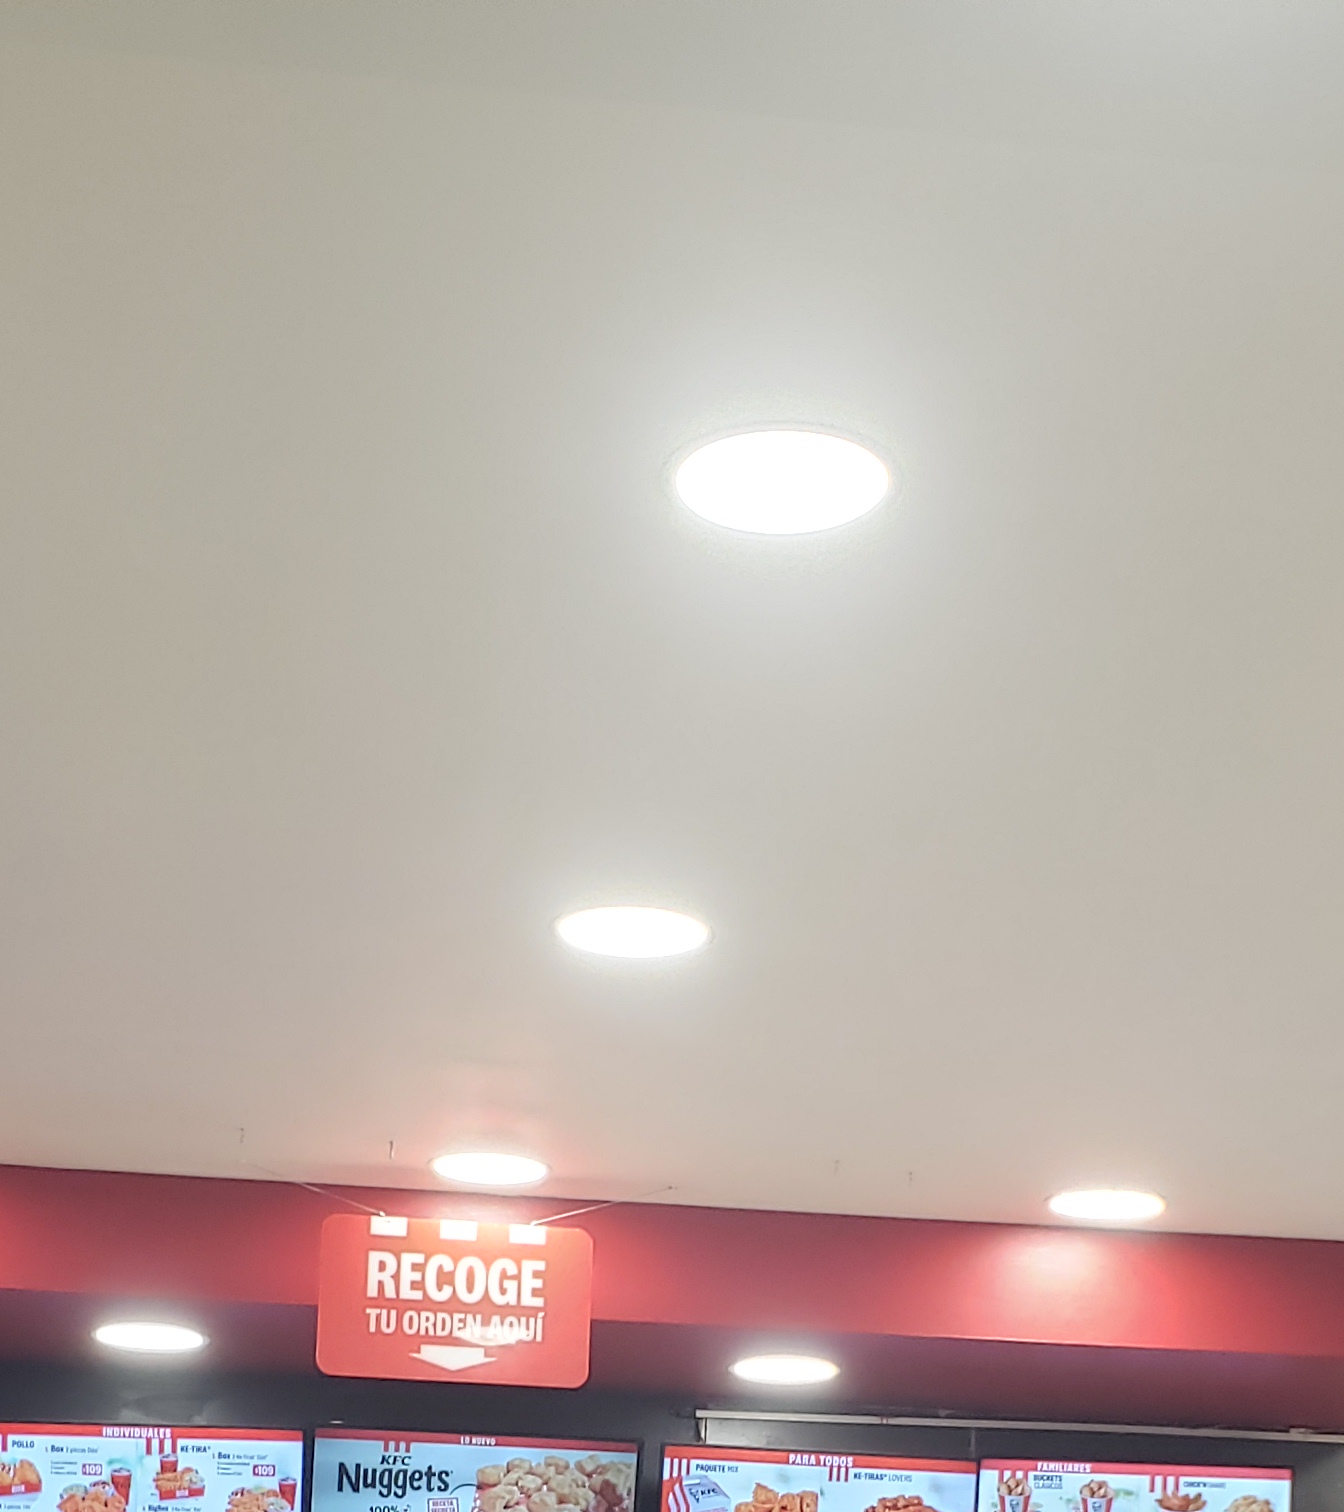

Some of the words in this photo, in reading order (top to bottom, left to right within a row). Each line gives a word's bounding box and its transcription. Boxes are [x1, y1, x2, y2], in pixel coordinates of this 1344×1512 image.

[366, 1250, 546, 1308] RECOGE
[366, 1308, 398, 1334] TU
[402, 1310, 482, 1339] ORDEN
[490, 1312, 545, 1343] AQUÍ
[102, 1426, 172, 1439] INDIVIDUALES
[12, 1440, 35, 1449] POLLO
[50, 1444, 64, 1453] Box
[460, 1436, 470, 1445] LO
[471, 1437, 496, 1446] NUEVO
[217, 1451, 231, 1460] Box
[379, 1454, 413, 1466] KFC
[788, 1453, 816, 1465] PARA
[819, 1456, 854, 1467] TODOS
[254, 1464, 275, 1476] $109
[695, 1463, 726, 1473] PAQUETE
[727, 1465, 739, 1473] MIX
[1036, 1462, 1092, 1473] FAMILIARES
[337, 1461, 450, 1499] Nuggets
[888, 1474, 913, 1483] LOVERS
[1033, 1474, 1063, 1482] BUCKETS
